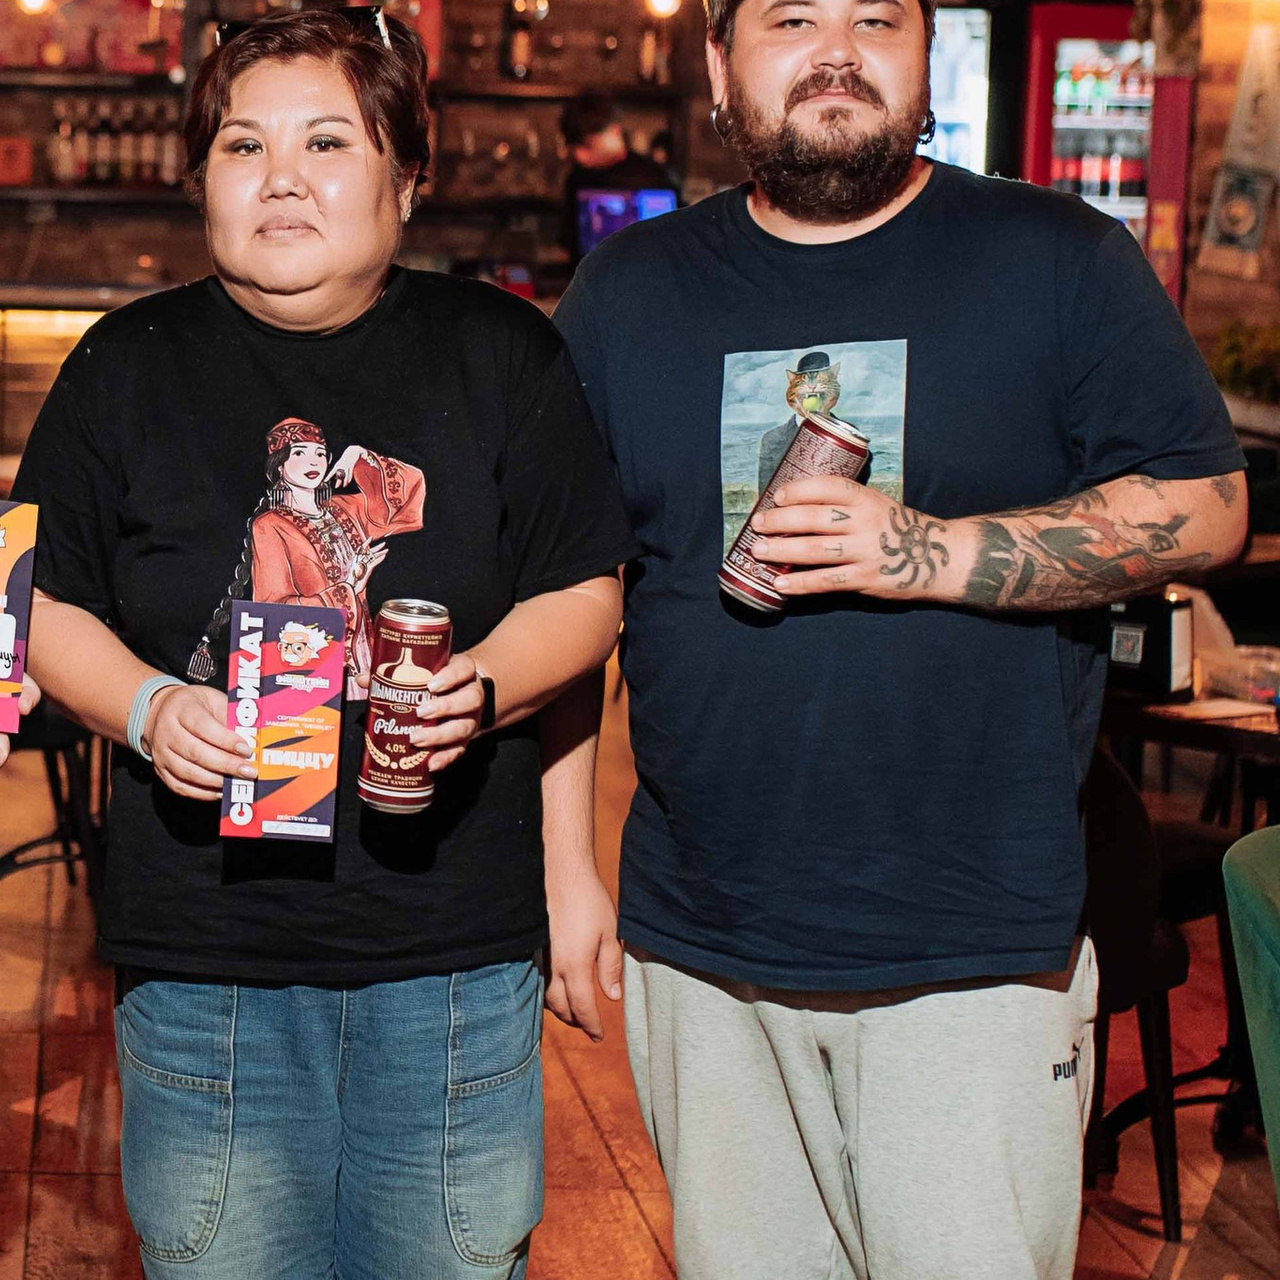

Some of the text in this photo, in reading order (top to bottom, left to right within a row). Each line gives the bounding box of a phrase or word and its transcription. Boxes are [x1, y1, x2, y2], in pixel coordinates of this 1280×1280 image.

[370, 680, 437, 705] ШЫМКЕНТСК
[229, 611, 264, 826] СЕИФИКАТ
[374, 718, 422, 735] Pilsne
[262, 748, 335, 770] ПИЦЦУ
[385, 742, 406, 754] 4,0%
